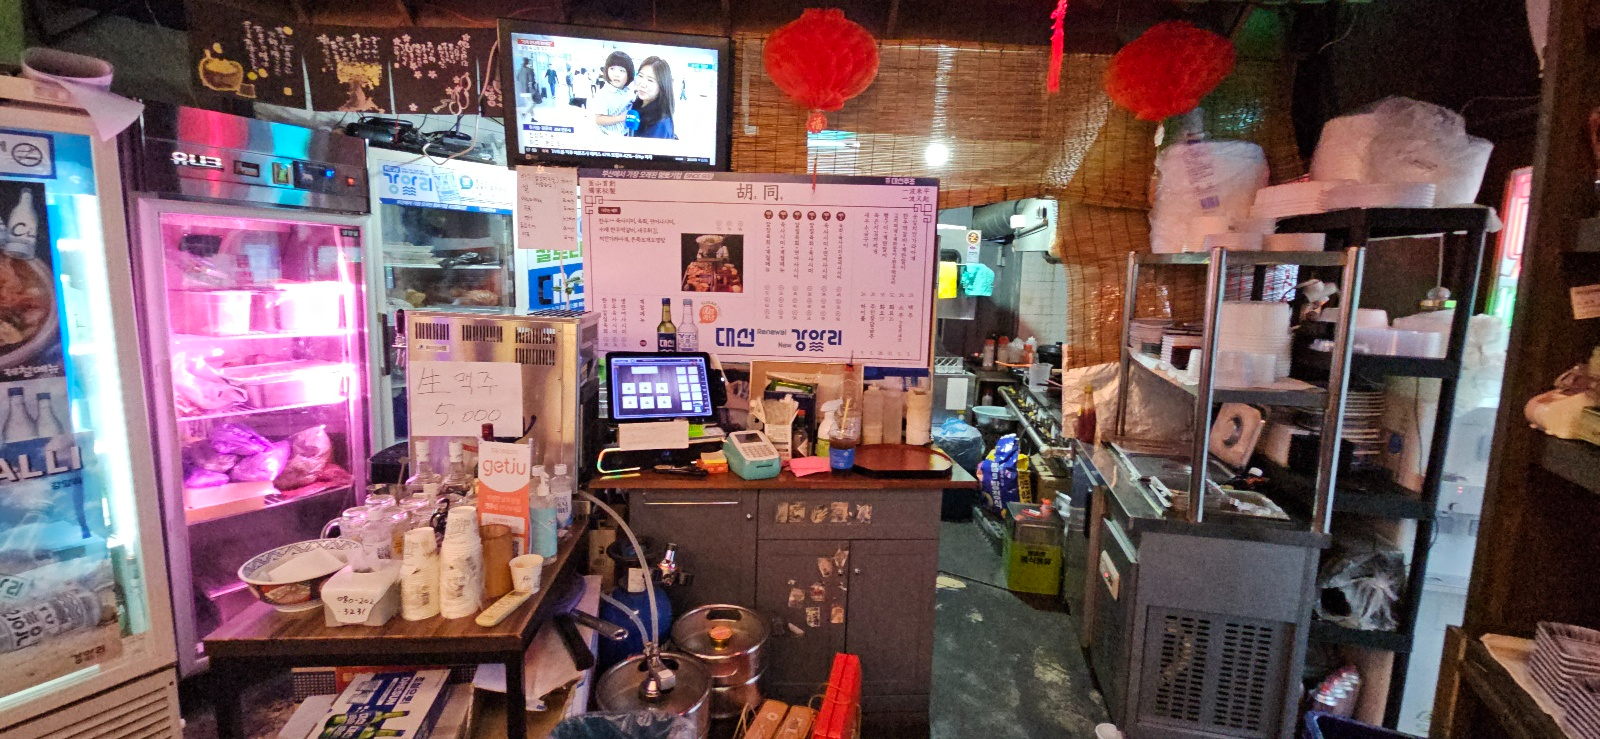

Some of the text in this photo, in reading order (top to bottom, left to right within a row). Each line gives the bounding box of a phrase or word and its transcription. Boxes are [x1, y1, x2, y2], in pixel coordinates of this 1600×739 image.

[602, 170, 626, 178] 부산에서
[715, 327, 787, 348] 대선 Renewal
[791, 328, 842, 352] 강알리
[417, 367, 498, 395] 生 맥주
[482, 458, 526, 476] getju
